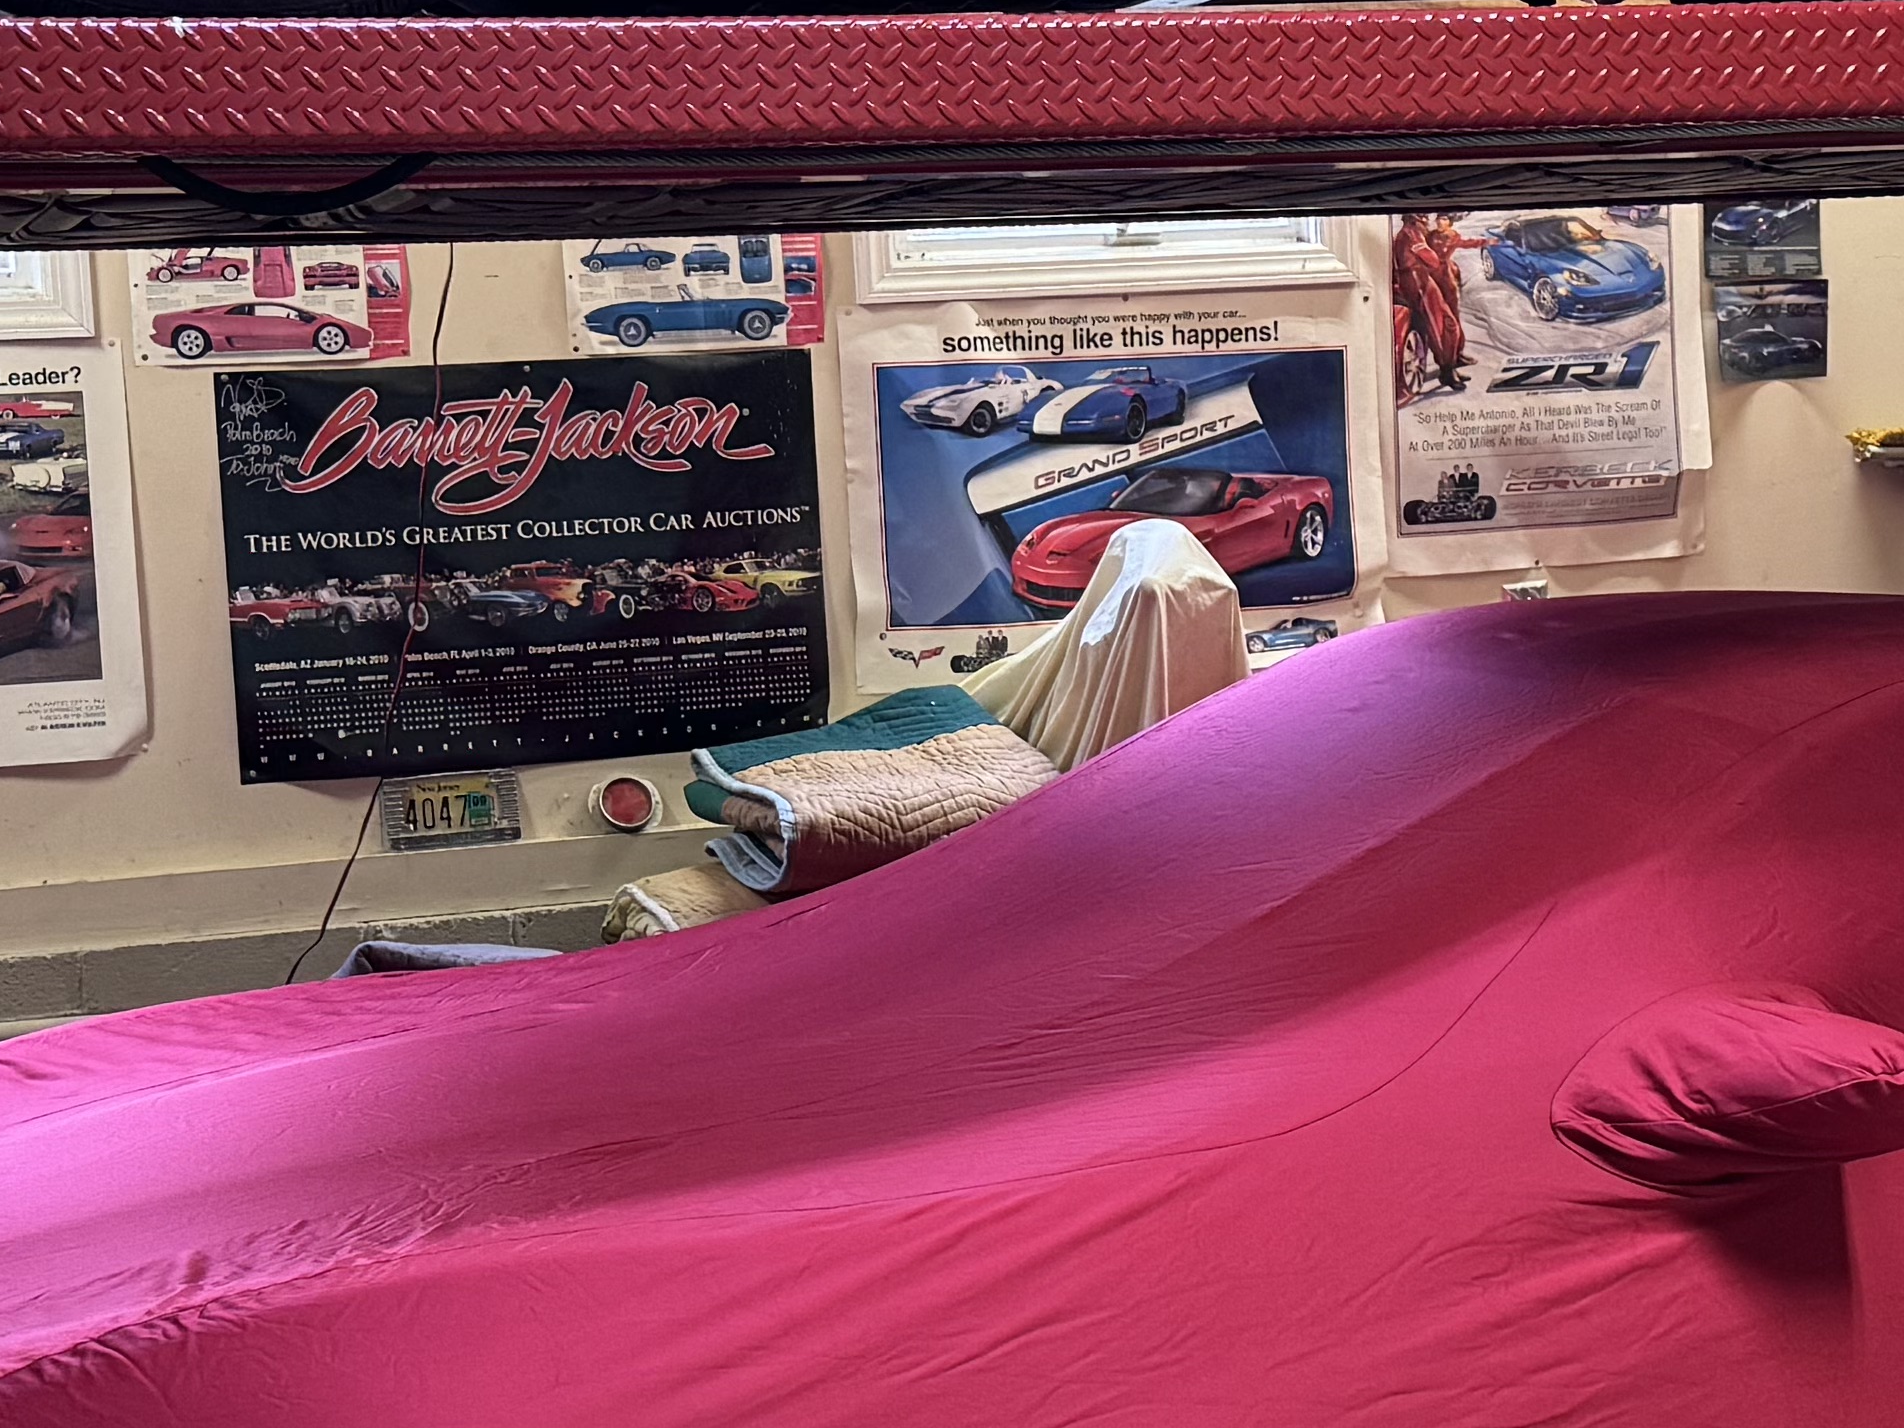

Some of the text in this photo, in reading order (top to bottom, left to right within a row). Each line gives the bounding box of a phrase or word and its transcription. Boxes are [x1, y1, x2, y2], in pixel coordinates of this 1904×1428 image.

[996, 316, 1024, 327] when
[1026, 316, 1047, 328] you
[1049, 313, 1089, 326] thought
[1091, 313, 1111, 325] you
[1113, 313, 1138, 324] were
[1139, 310, 1173, 324] happy
[1173, 309, 1196, 322] with
[1197, 309, 1221, 323] your
[942, 319, 1280, 356] something like this happens!
[1490, 341, 1661, 390] ZR1
[1505, 351, 1613, 365] SUPERCHARGED
[1433, 411, 1458, 424] Help
[1460, 410, 1476, 422] Me
[1521, 406, 1536, 419] All
[1544, 404, 1572, 417] Heard
[1595, 402, 1613, 414] The
[1614, 400, 1649, 413] Scream
[1650, 398, 1662, 411] Of
[1441, 425, 1450, 437] A
[1451, 422, 1517, 438] Supercharger
[1518, 420, 1532, 432] As
[1535, 419, 1555, 432] That
[1607, 415, 1619, 429] By
[1621, 414, 1637, 427] Me
[276, 377, 776, 516] Barrett-Jackson
[1408, 441, 1420, 452] At
[1421, 439, 1445, 452] Over
[1447, 438, 1467, 451] 200
[1469, 436, 1497, 449] Miles
[1498, 435, 1513, 448] An
[1587, 430, 1615, 443] Street
[1616, 427, 1642, 443] Legal
[1033, 415, 1236, 490] GRAND SPORT
[1504, 458, 1674, 480] KERBECK
[1505, 474, 1663, 493] CORVETTE
[243, 512, 696, 554] THE WORLD'S GREATEST COLLECTOR CAR
